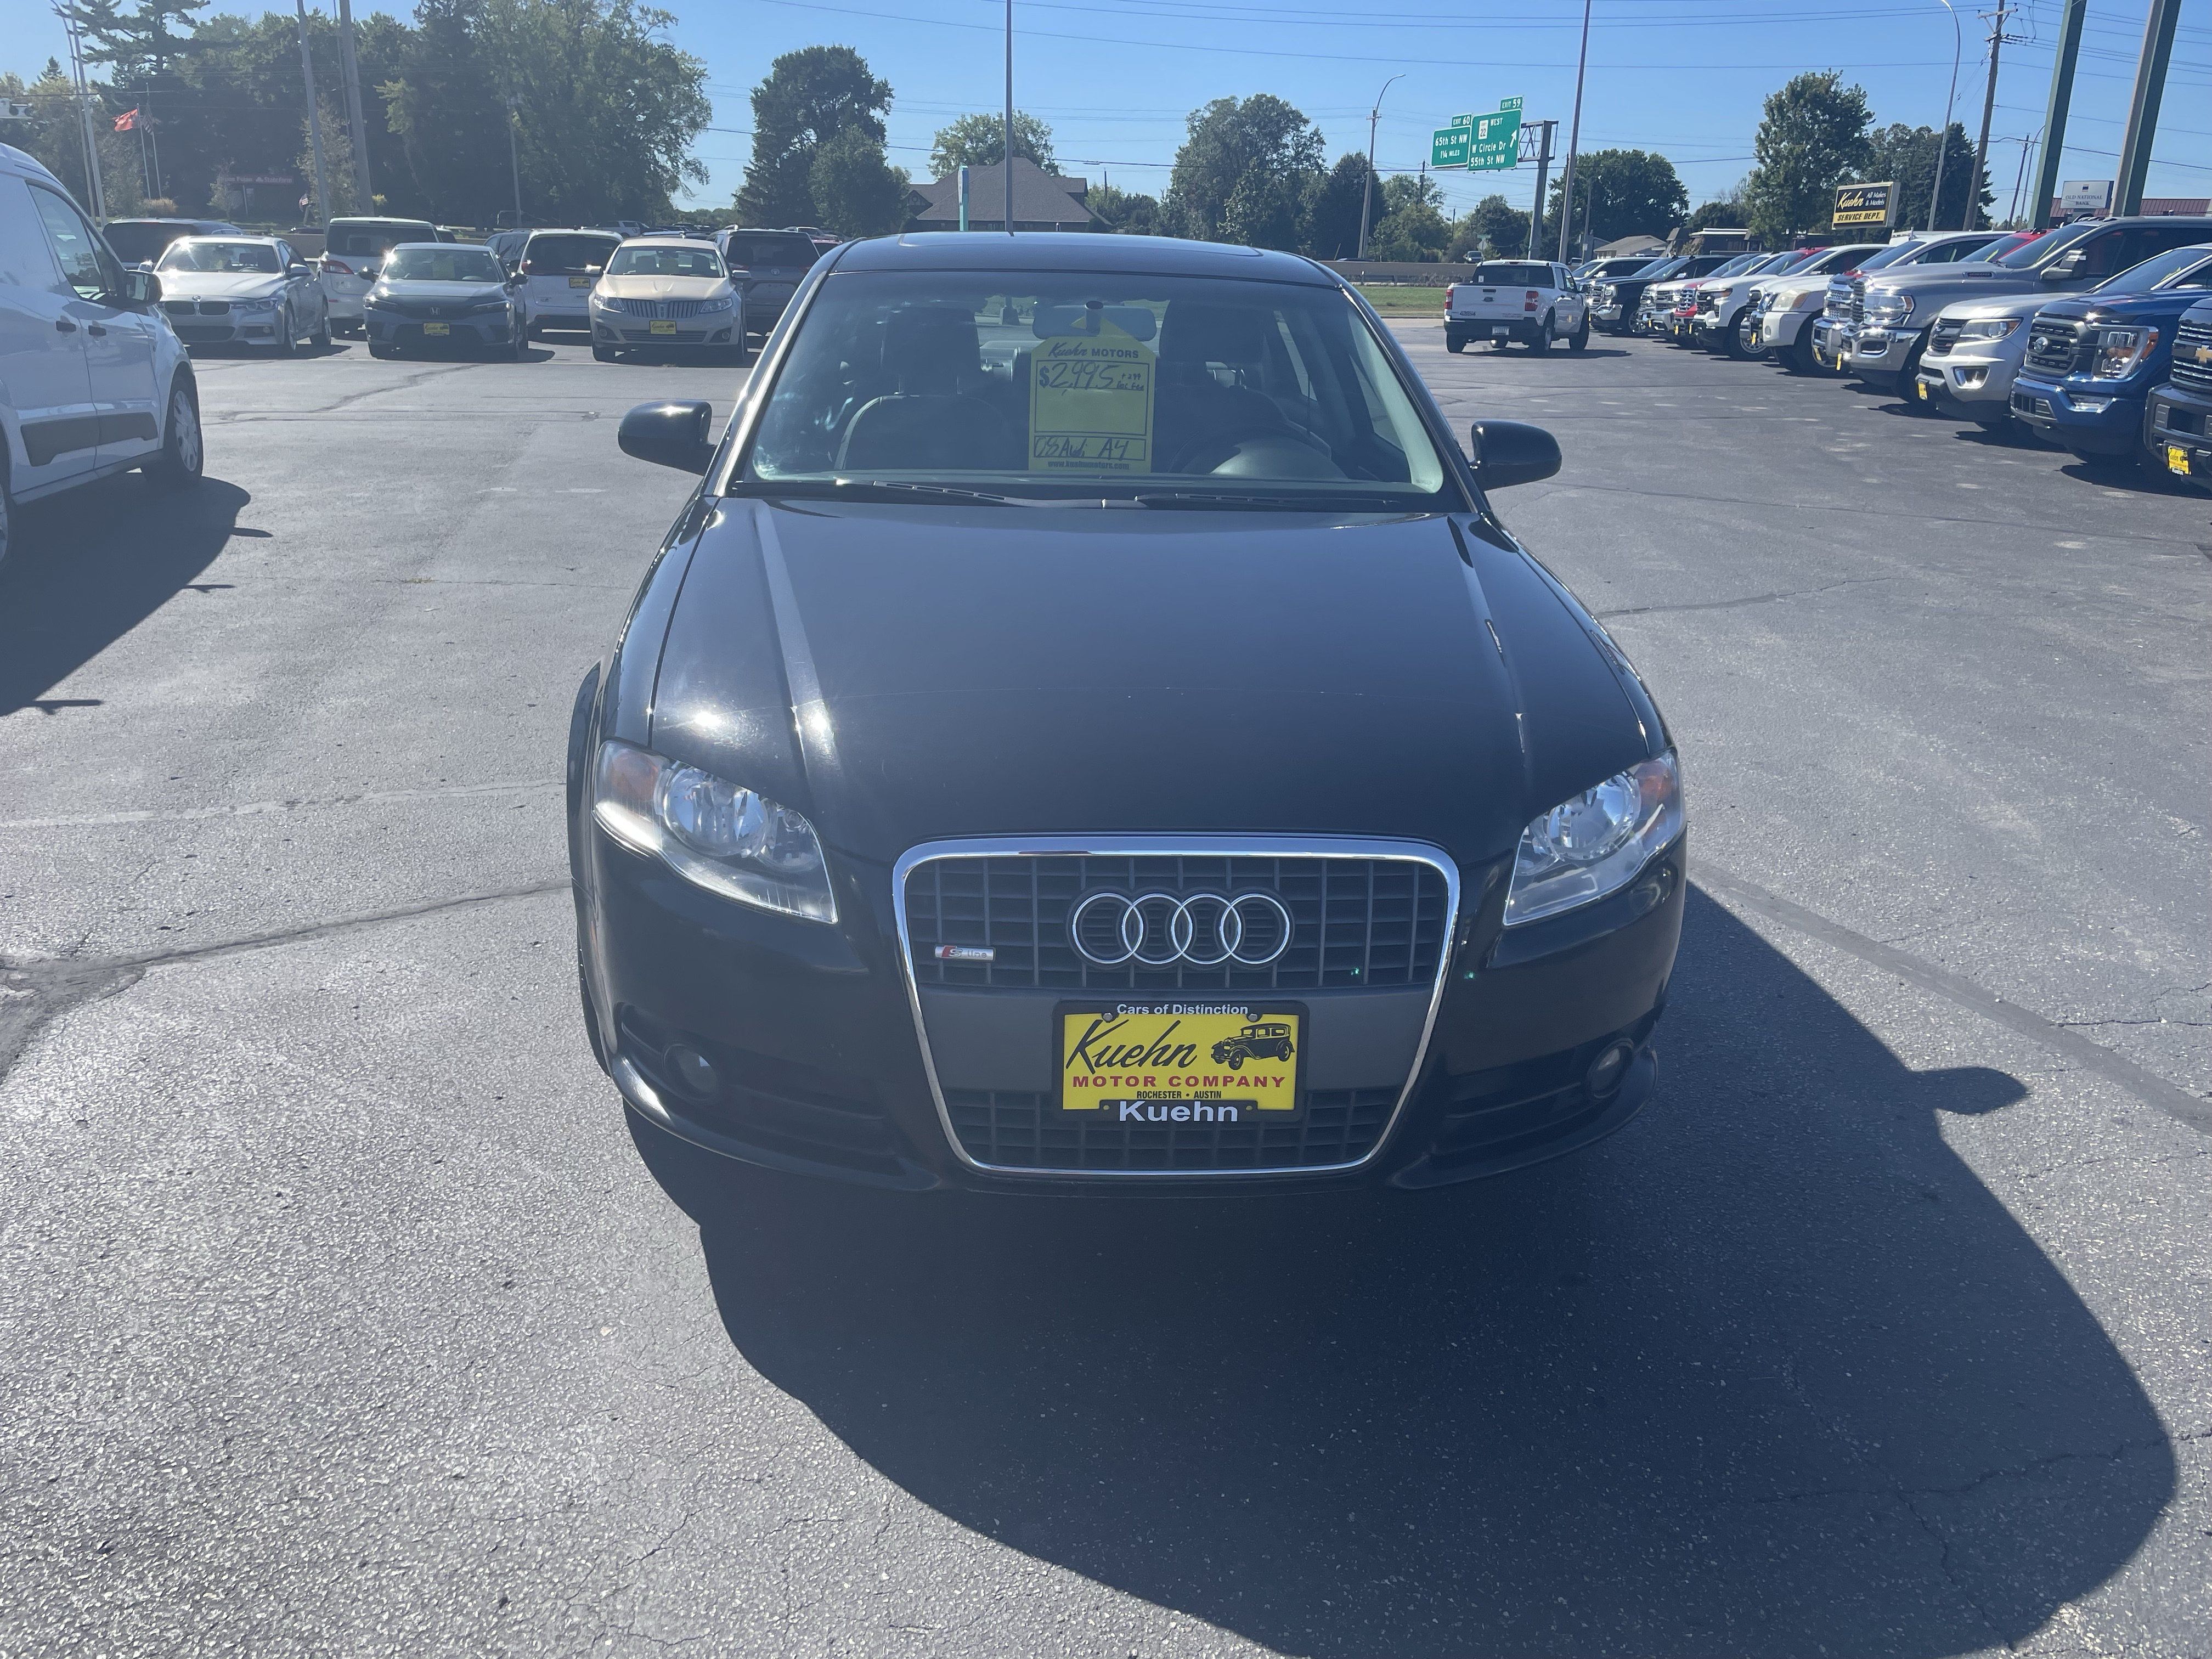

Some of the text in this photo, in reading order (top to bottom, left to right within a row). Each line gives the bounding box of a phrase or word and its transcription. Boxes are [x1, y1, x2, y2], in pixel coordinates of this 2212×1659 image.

[1513, 98, 1521, 108] 59
[1463, 115, 1470, 125] 60
[1490, 117, 1503, 126] WEST
[1480, 128, 1486, 137] 22
[1435, 134, 1468, 146] 65th St NW
[1449, 149, 1460, 157] MILES
[1472, 141, 1506, 154] W Circle Dr
[1470, 154, 1505, 167] 55th St NW
[1837, 190, 1864, 210] Kuehn
[1869, 198, 1885, 206] Models
[1837, 213, 1863, 222] SERVICE
[1048, 342, 1139, 358] Kuehn MOTORS
[1097, 438, 1130, 461] A4
[1116, 1003, 1249, 1014] Cars of Distinction
[1065, 1019, 1197, 1075] Kuehn
[1073, 1076, 1285, 1087] MOTOR COMPANY
[1137, 1091, 1222, 1099] ROCHESTER AUSTIN
[1119, 1101, 1238, 1122] Kuehn
